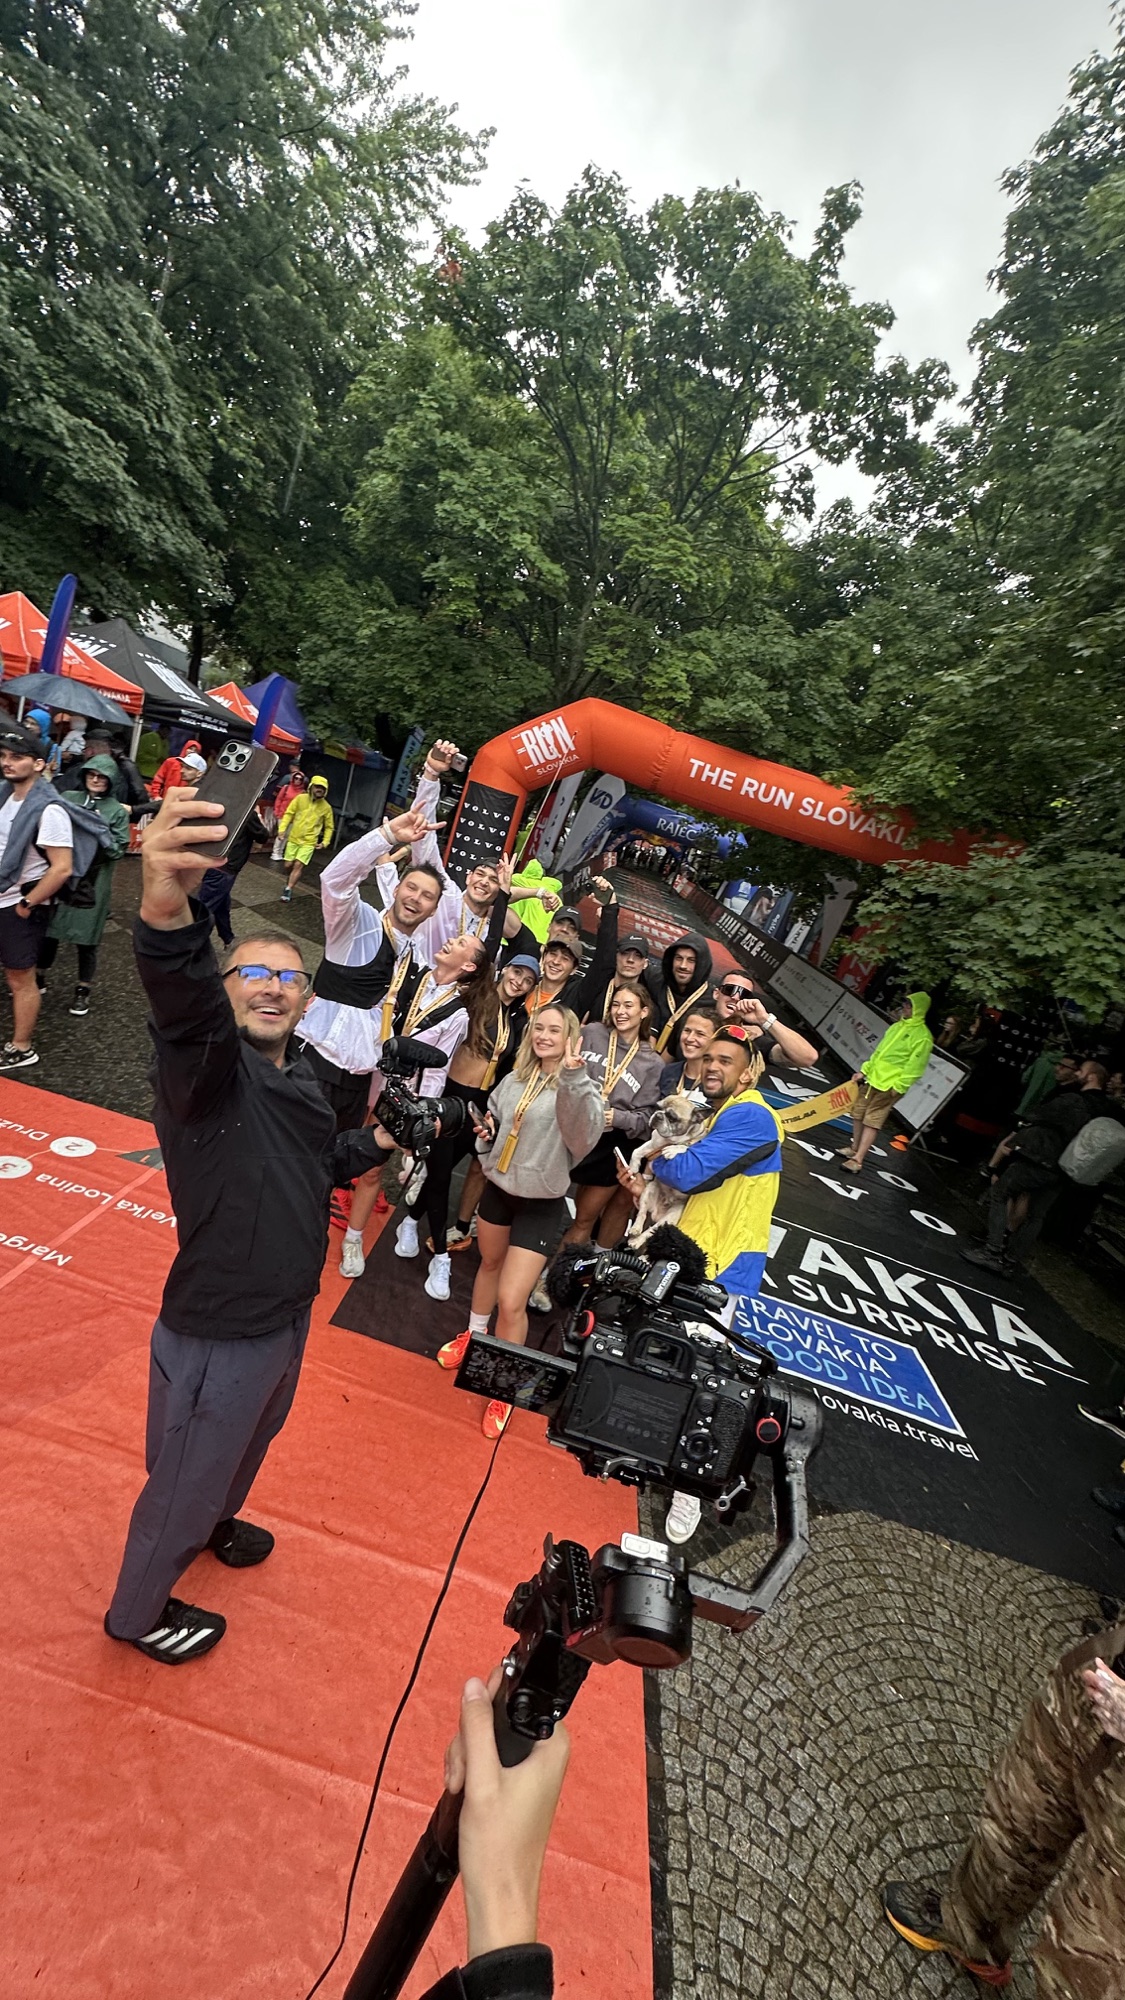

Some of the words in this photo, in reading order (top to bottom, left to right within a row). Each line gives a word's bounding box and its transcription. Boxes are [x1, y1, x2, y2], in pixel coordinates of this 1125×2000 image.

[536, 753, 580, 776] SLOVAKIA
[463, 802, 511, 822] VOLVO
[689, 757, 738, 792] THE
[739, 776, 795, 810] RUN
[798, 796, 905, 845] SLOVAKI
[459, 817, 506, 837] VOLVO
[656, 817, 698, 841] RAJEC
[455, 832, 502, 852] VOLVO
[65, 1142, 83, 1151] 2
[139, 1155, 150, 1164] 1
[35, 1173, 114, 1206] Lodina
[738, 1294, 846, 1345] TRAVEL
[849, 1332, 898, 1363] TO
[787, 1274, 1047, 1386] SURPRISE
[735, 1310, 892, 1379] SLOVAKIA
[859, 1372, 941, 1417] IDEA
[813, 1387, 980, 1462] lovakia.travel
